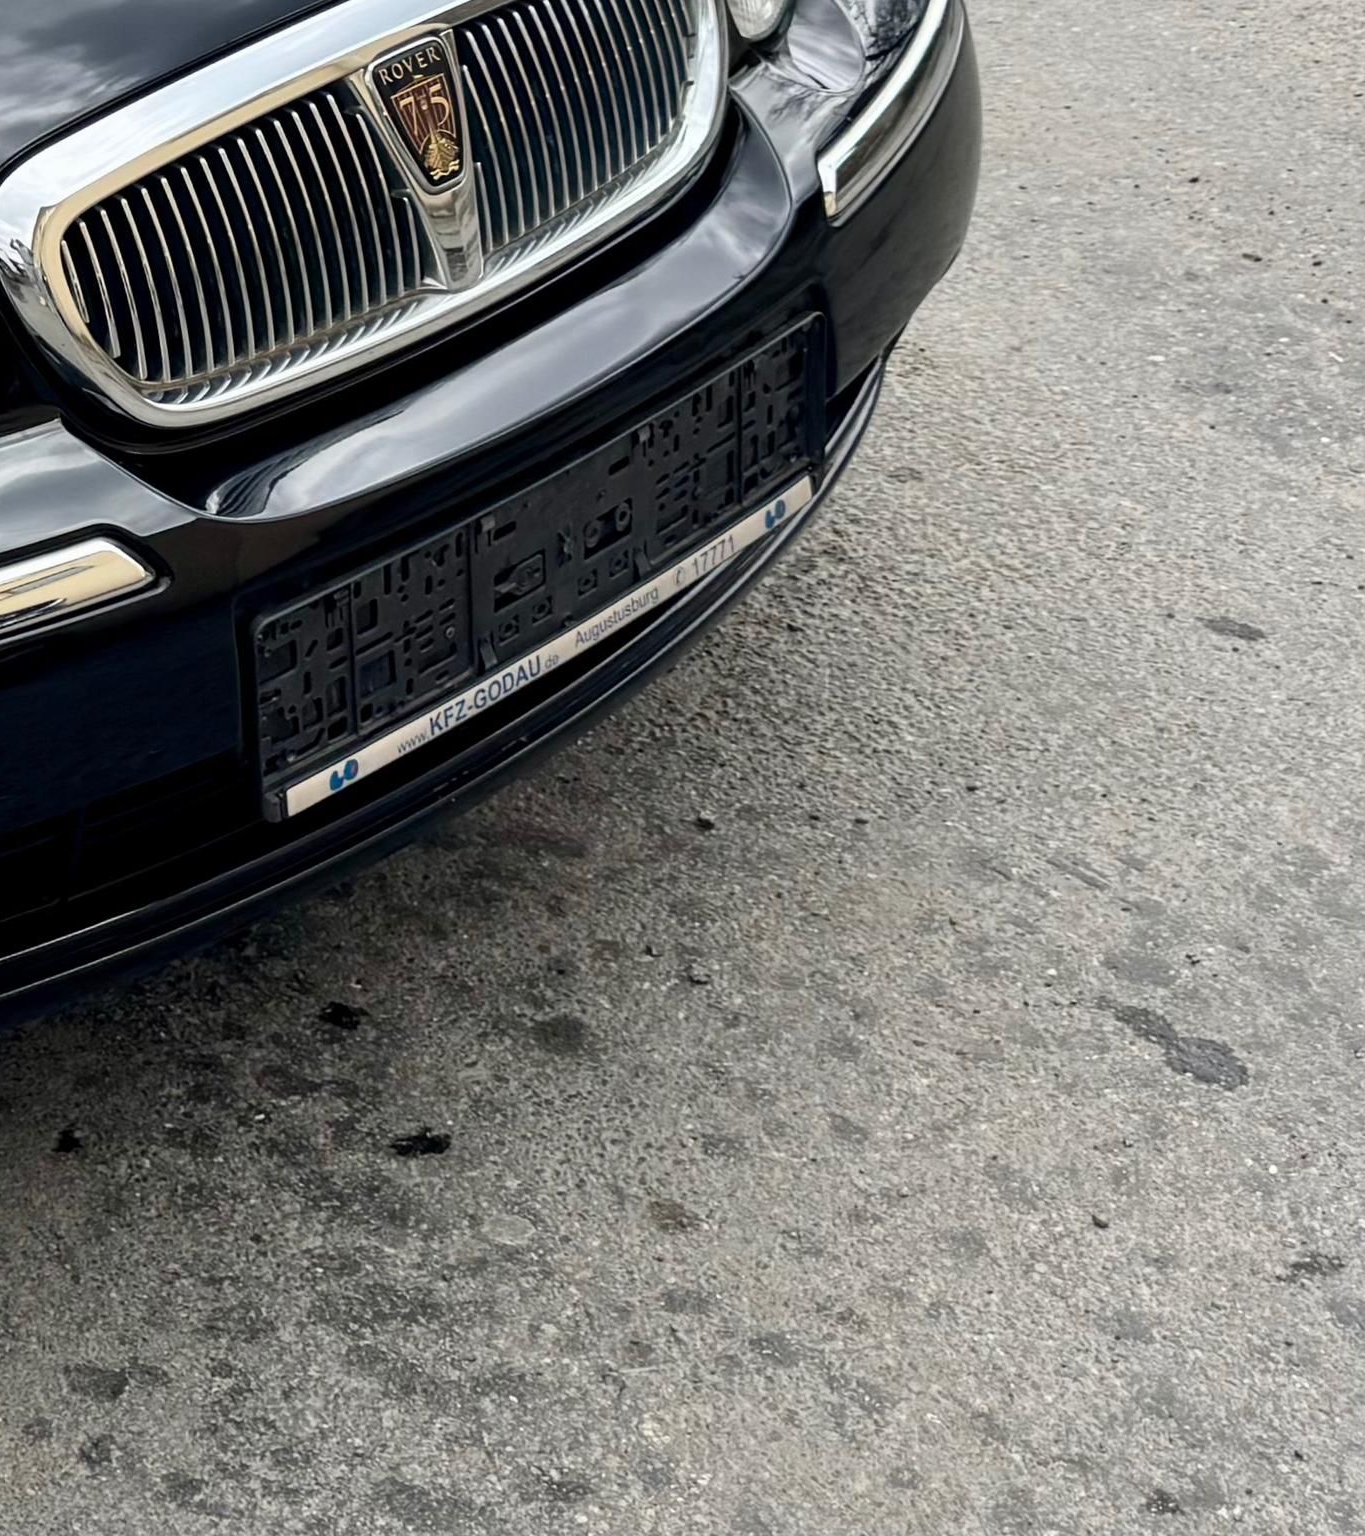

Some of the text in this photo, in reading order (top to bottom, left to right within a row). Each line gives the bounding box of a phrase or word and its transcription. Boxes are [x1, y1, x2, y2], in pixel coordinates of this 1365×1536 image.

[378, 47, 441, 85] ROVER
[400, 83, 450, 136] 75
[574, 587, 660, 649] Augustusburg
